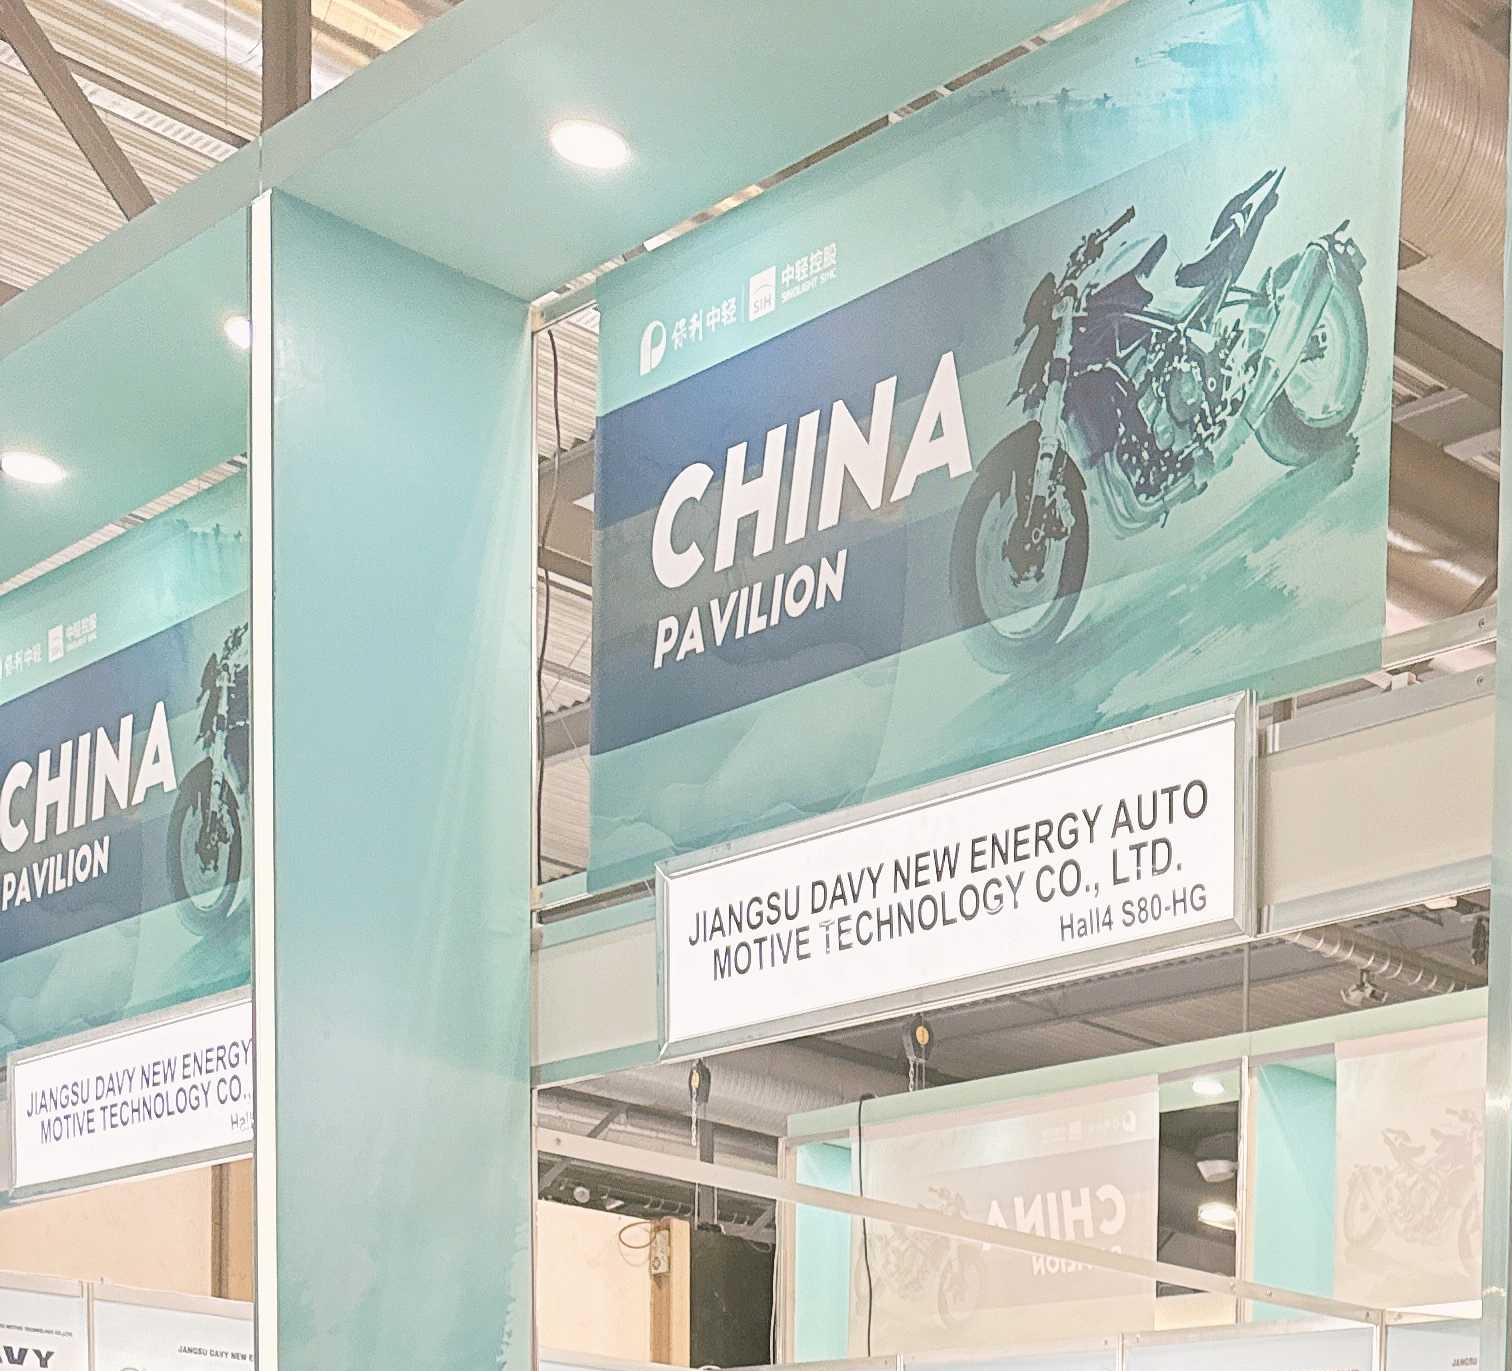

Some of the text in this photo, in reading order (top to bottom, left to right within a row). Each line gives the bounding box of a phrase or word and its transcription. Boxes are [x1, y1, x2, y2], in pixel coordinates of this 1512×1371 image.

[651, 351, 973, 589] CHINA
[652, 549, 848, 670] PAVILION
[0, 701, 177, 852] CHINA
[2, 836, 110, 911] PAVILION
[688, 779, 1208, 946] JIANGSU DAVY NEW ENERGY AUTO
[713, 837, 1182, 981] MOTIVE TECHNOLOGY CO., LTD.
[1059, 883, 1207, 942] Hall4 S80-HG
[27, 1039, 253, 1118] JIANGSU DAVY NEW ENERGY
[41, 1108, 96, 1144] MOTIVE
[101, 1081, 212, 1132] TECHNOLOGY
